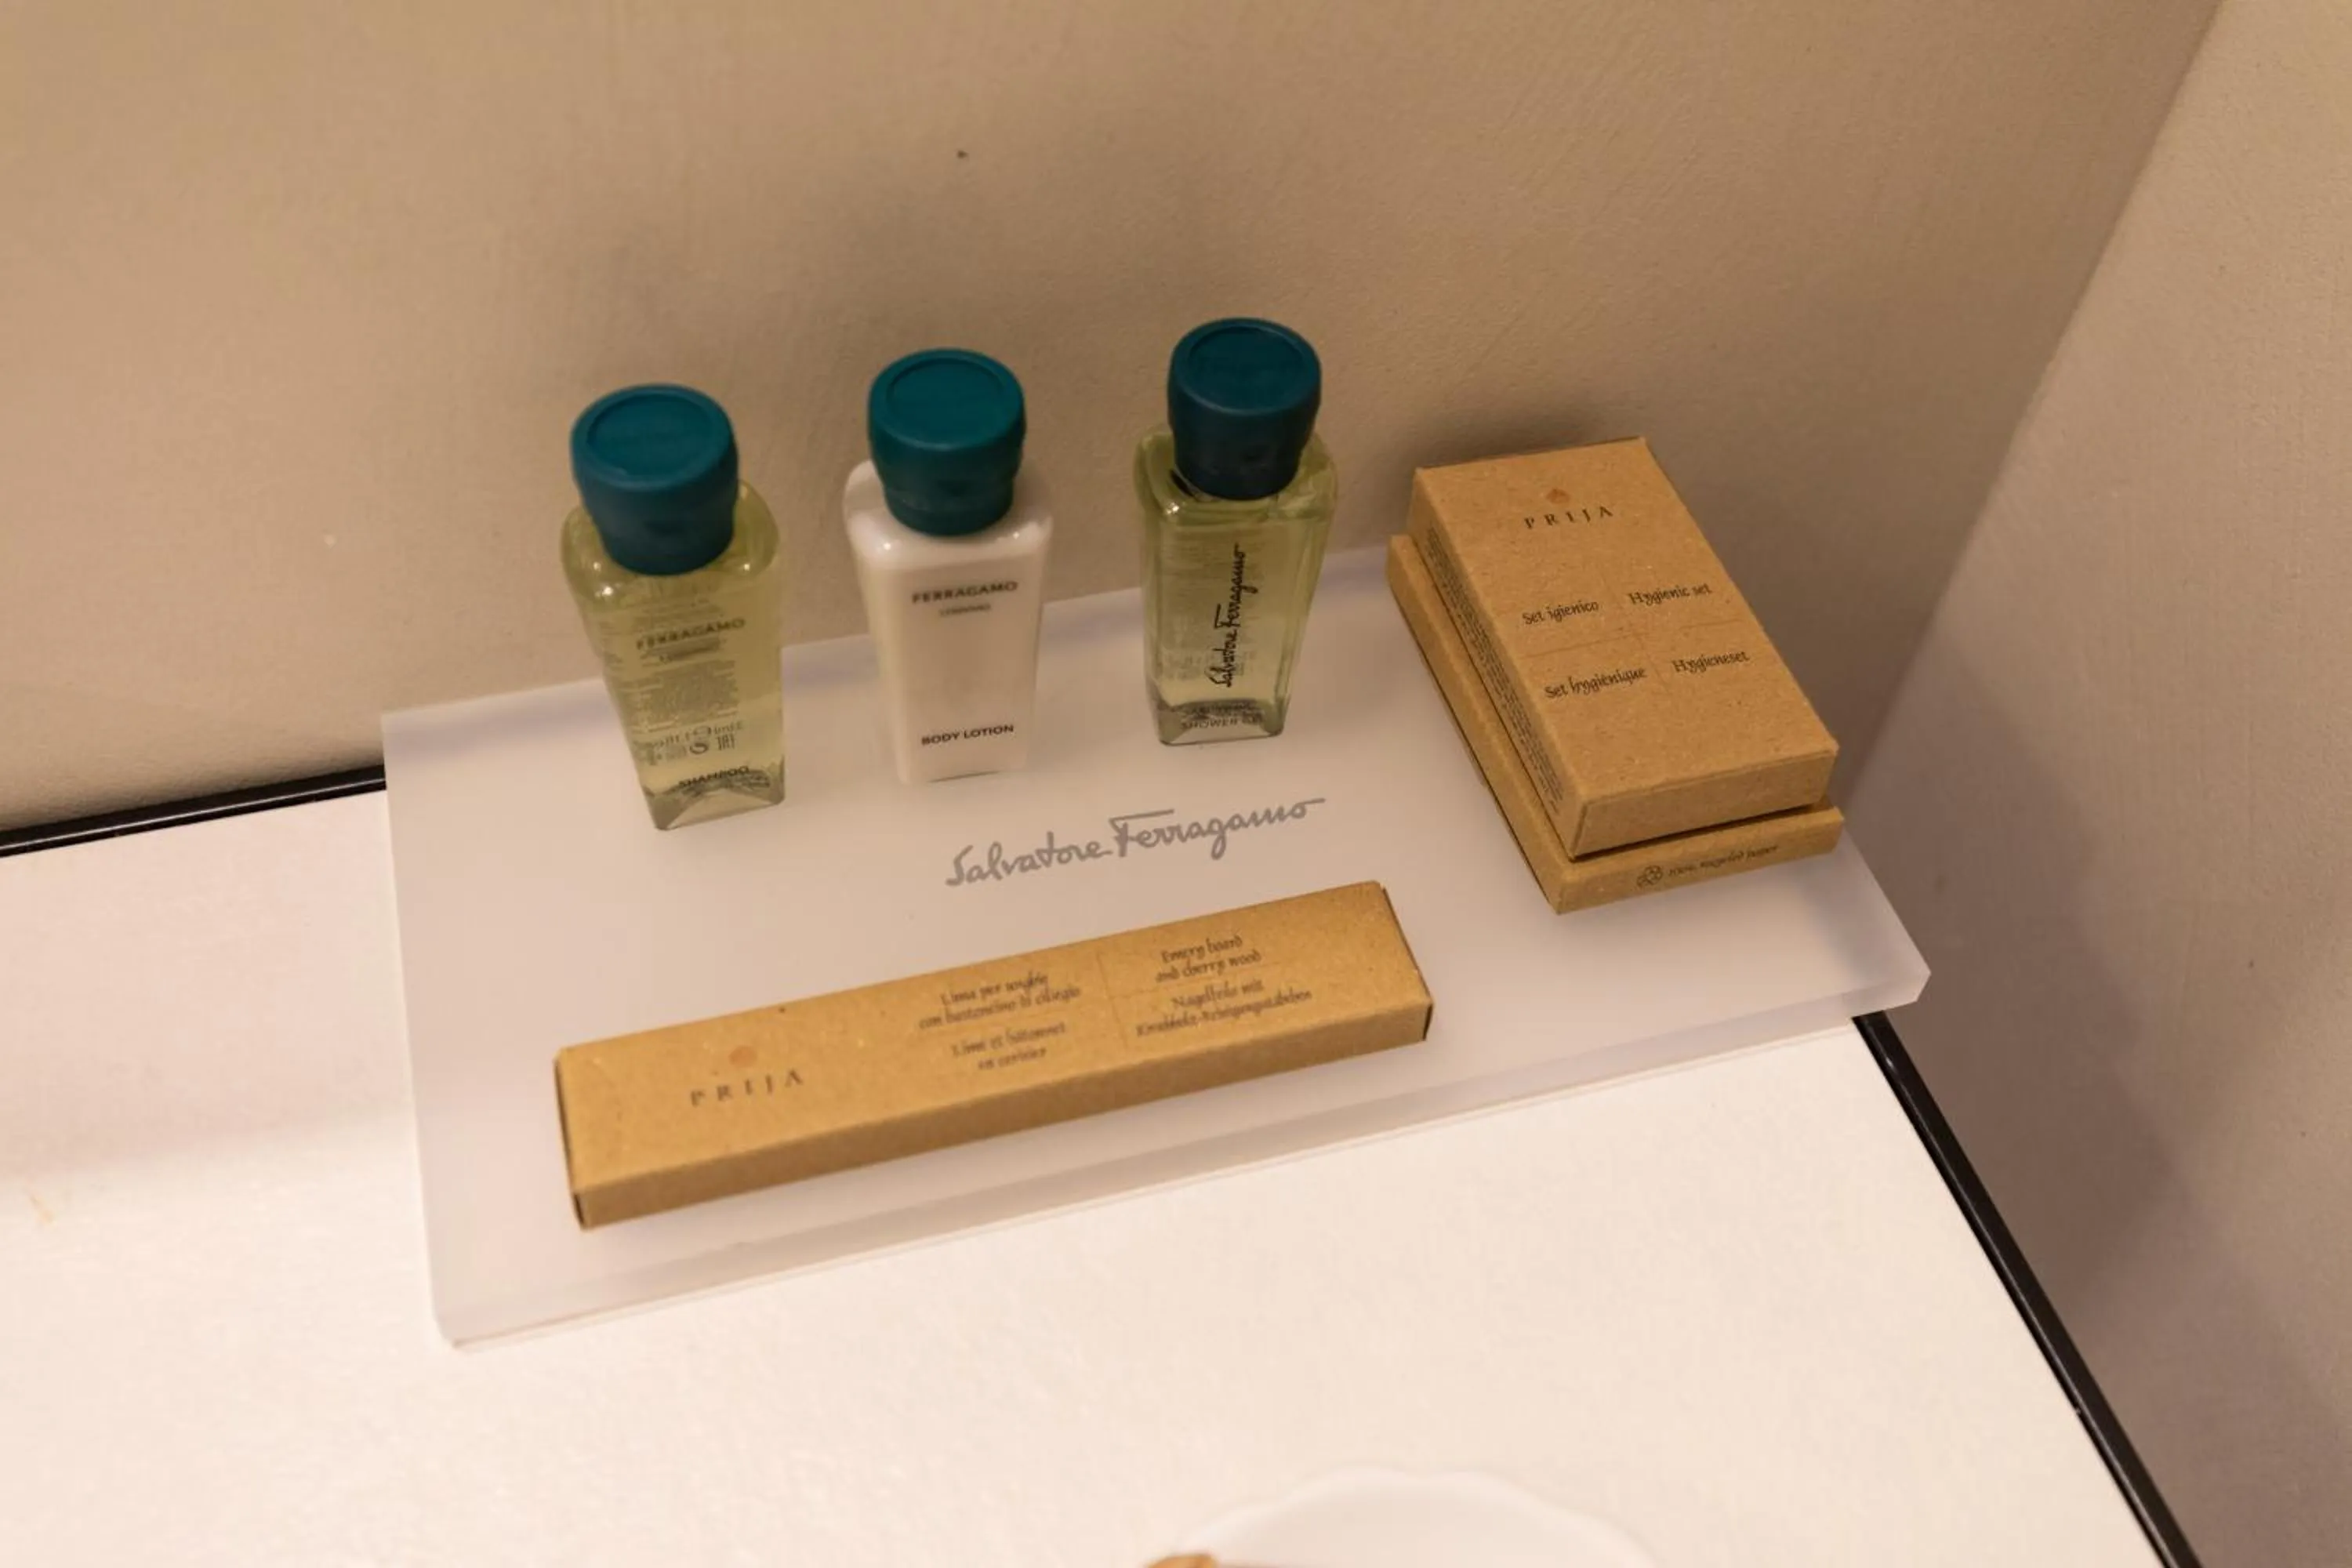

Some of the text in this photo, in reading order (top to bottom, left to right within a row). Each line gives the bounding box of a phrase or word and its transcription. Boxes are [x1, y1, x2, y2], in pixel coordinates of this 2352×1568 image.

[1524, 505, 1613, 529] PRIJA
[912, 580, 1019, 604] FERRAGAMO
[1628, 583, 1713, 605] Hygienic set
[1522, 601, 1599, 625] Set igienico
[1672, 650, 1751, 674] Hygieneset
[1544, 686, 1569, 699] Set
[921, 724, 1014, 746] BODY LOTION
[945, 797, 1326, 886] Salvatore Ferragamo
[689, 1068, 804, 1109] PRIJA
